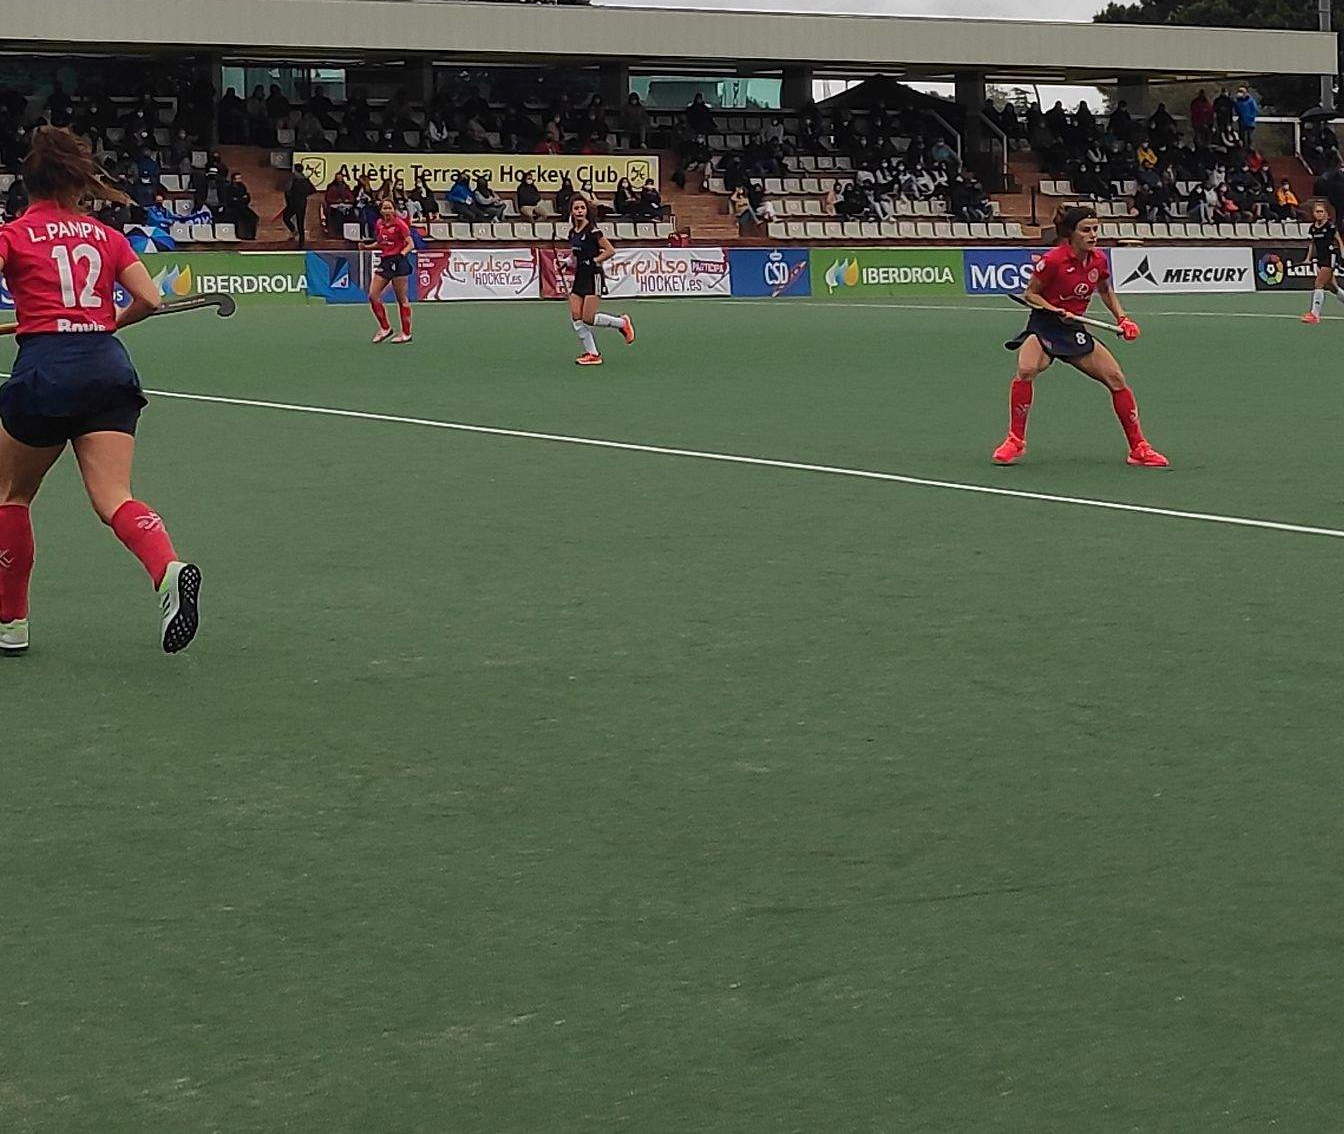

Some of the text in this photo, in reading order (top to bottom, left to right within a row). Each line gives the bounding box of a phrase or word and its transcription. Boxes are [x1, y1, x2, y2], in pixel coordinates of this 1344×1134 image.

[340, 162, 618, 185] Atlètic Terrassa Hockey Club
[50, 243, 102, 308] 12
[453, 255, 512, 278] impulso
[609, 251, 688, 282] impulso
[764, 261, 789, 286] CSD
[861, 266, 955, 285] IBERDROLA
[970, 264, 1036, 290] MGS
[1162, 266, 1249, 284] MERCURY
[196, 274, 308, 295] IBERDROLA
[640, 275, 702, 292] HOCKEY.es
[1075, 332, 1088, 345] 8
